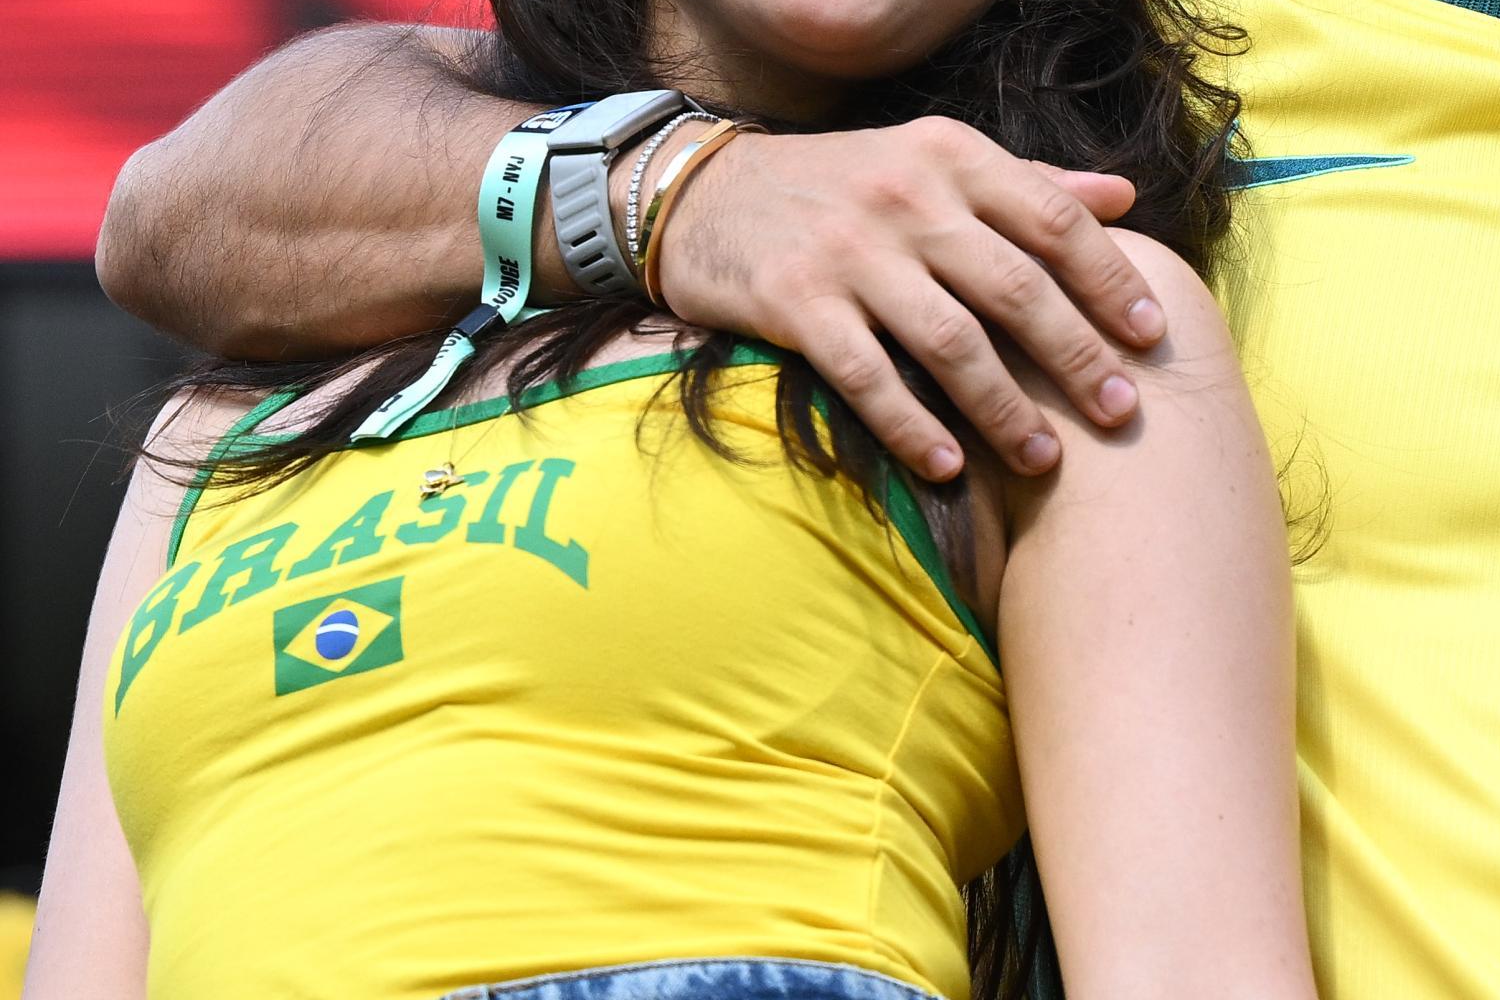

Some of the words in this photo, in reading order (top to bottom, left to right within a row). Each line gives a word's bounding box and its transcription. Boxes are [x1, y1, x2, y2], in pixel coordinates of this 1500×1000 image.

[502, 156, 525, 183] NYJ
[496, 196, 515, 221] M7
[114, 457, 590, 720] BRASIL
